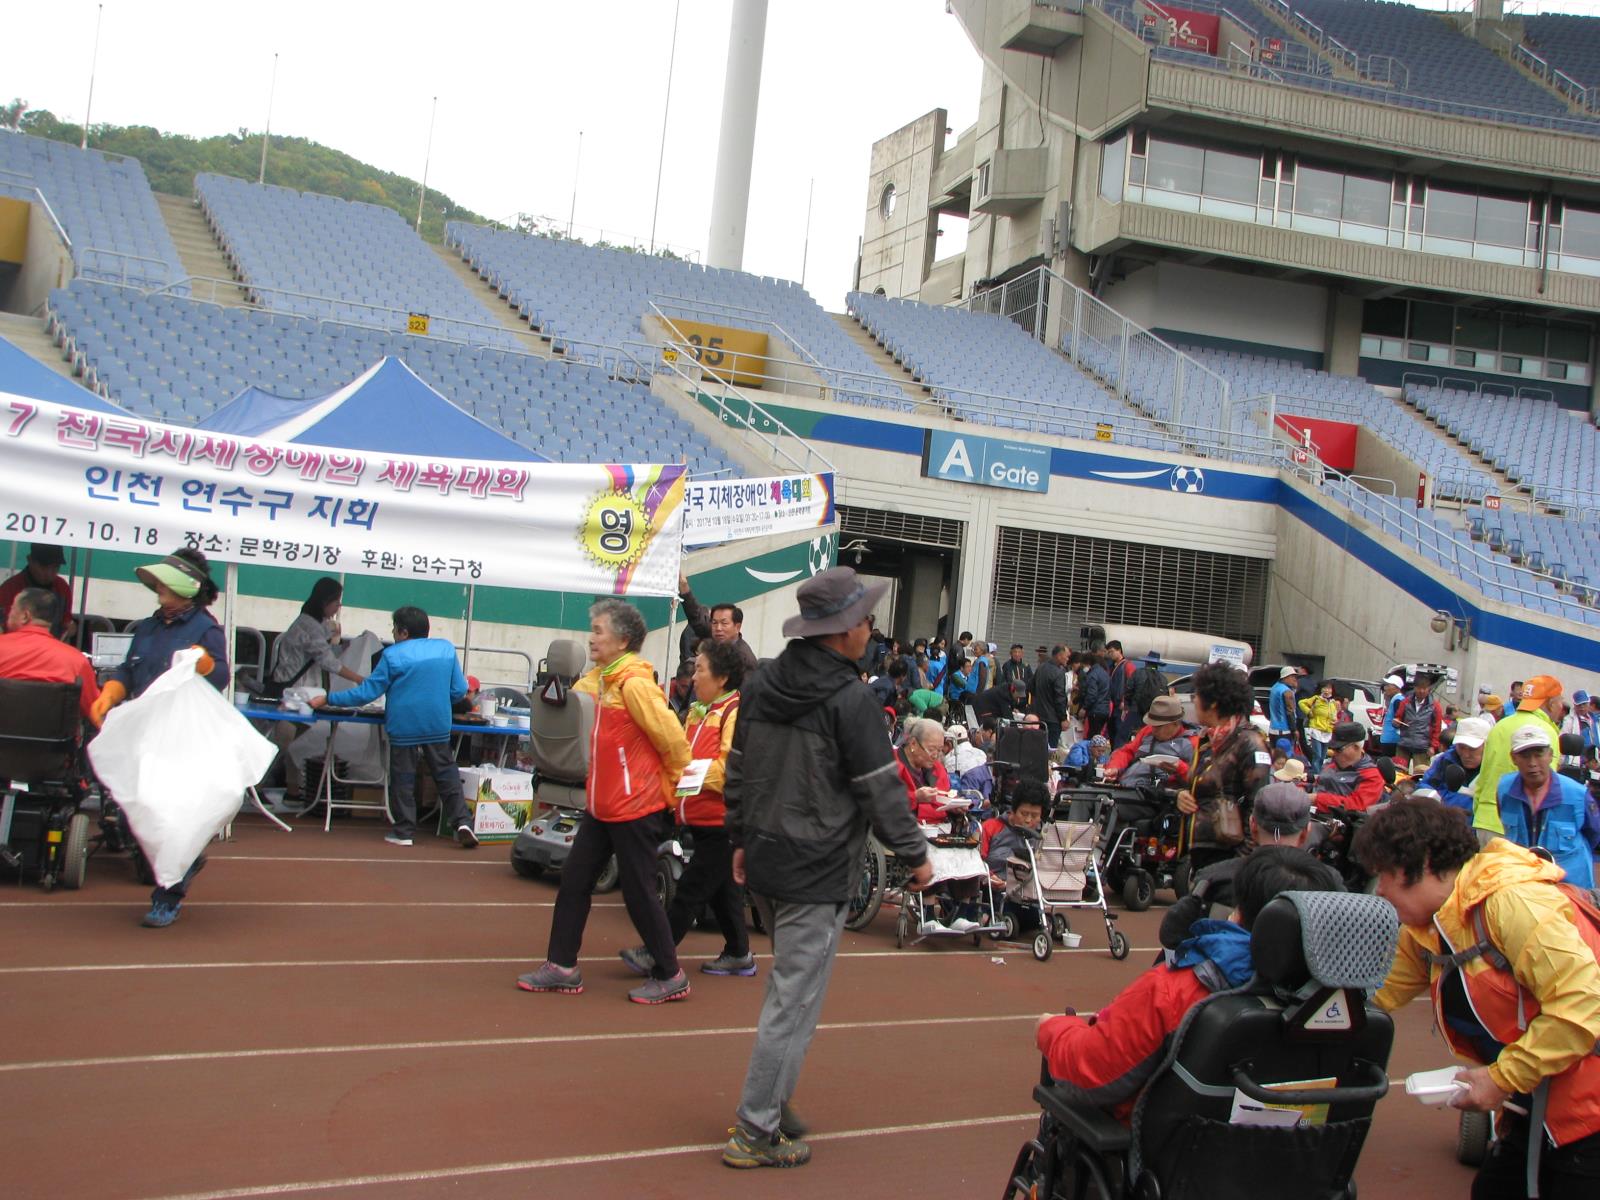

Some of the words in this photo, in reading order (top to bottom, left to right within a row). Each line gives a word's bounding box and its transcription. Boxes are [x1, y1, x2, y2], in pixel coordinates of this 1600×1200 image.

[1167, 17, 1192, 40] 36
[688, 334, 724, 365] 35
[8, 401, 35, 435] 7
[1303, 428, 1311, 448] 1
[938, 438, 974, 477] A
[990, 461, 1040, 486] Gate
[85, 466, 164, 507] 인천
[181, 479, 295, 521] 연수구
[307, 494, 380, 531] 지회
[708, 483, 767, 510] 지체장애인
[770, 478, 813, 505] 체육대회
[6, 512, 74, 537] 2017.
[88, 521, 120, 542] 10.
[133, 526, 159, 545] 18
[184, 531, 231, 554] 장소:
[239, 537, 342, 566] 문학경기장
[361, 549, 404, 571] 후원:
[411, 554, 484, 580] 연수구청
[600, 509, 633, 553] 영
